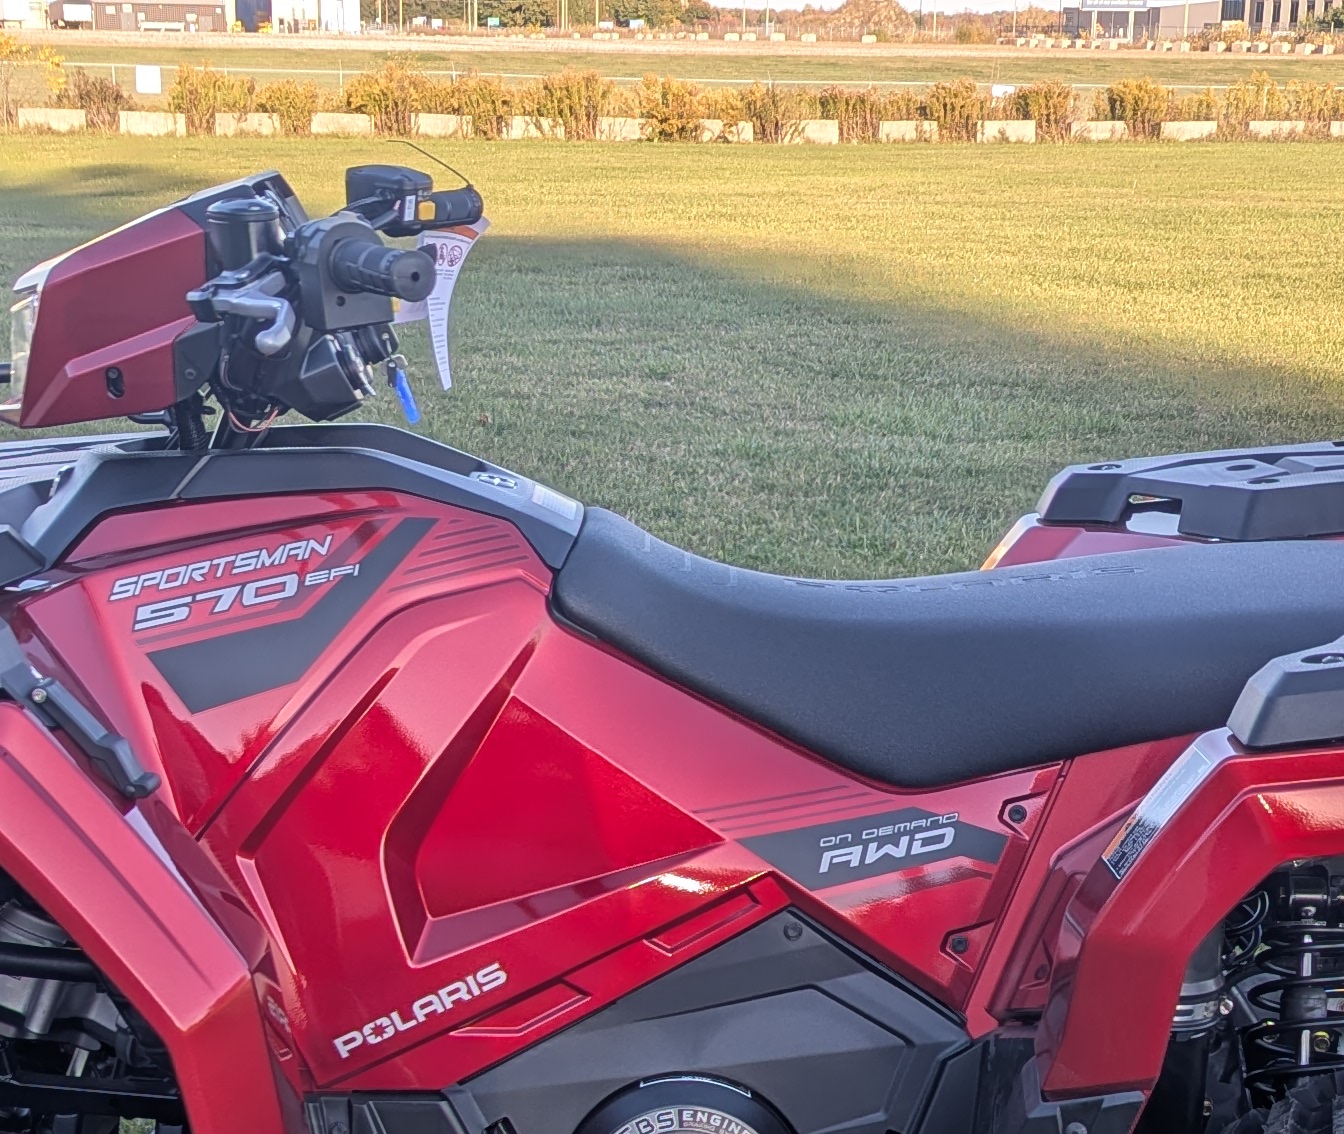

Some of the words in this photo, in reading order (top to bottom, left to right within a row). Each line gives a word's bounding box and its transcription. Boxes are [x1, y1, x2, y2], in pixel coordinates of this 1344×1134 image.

[109, 536, 335, 601] SPORTSMAN
[132, 573, 299, 632] 570
[304, 563, 361, 586] EFI
[819, 832, 853, 848] ON
[862, 812, 959, 840] DEMAND
[819, 826, 956, 874] AWD
[332, 961, 508, 1059] POLARIS
